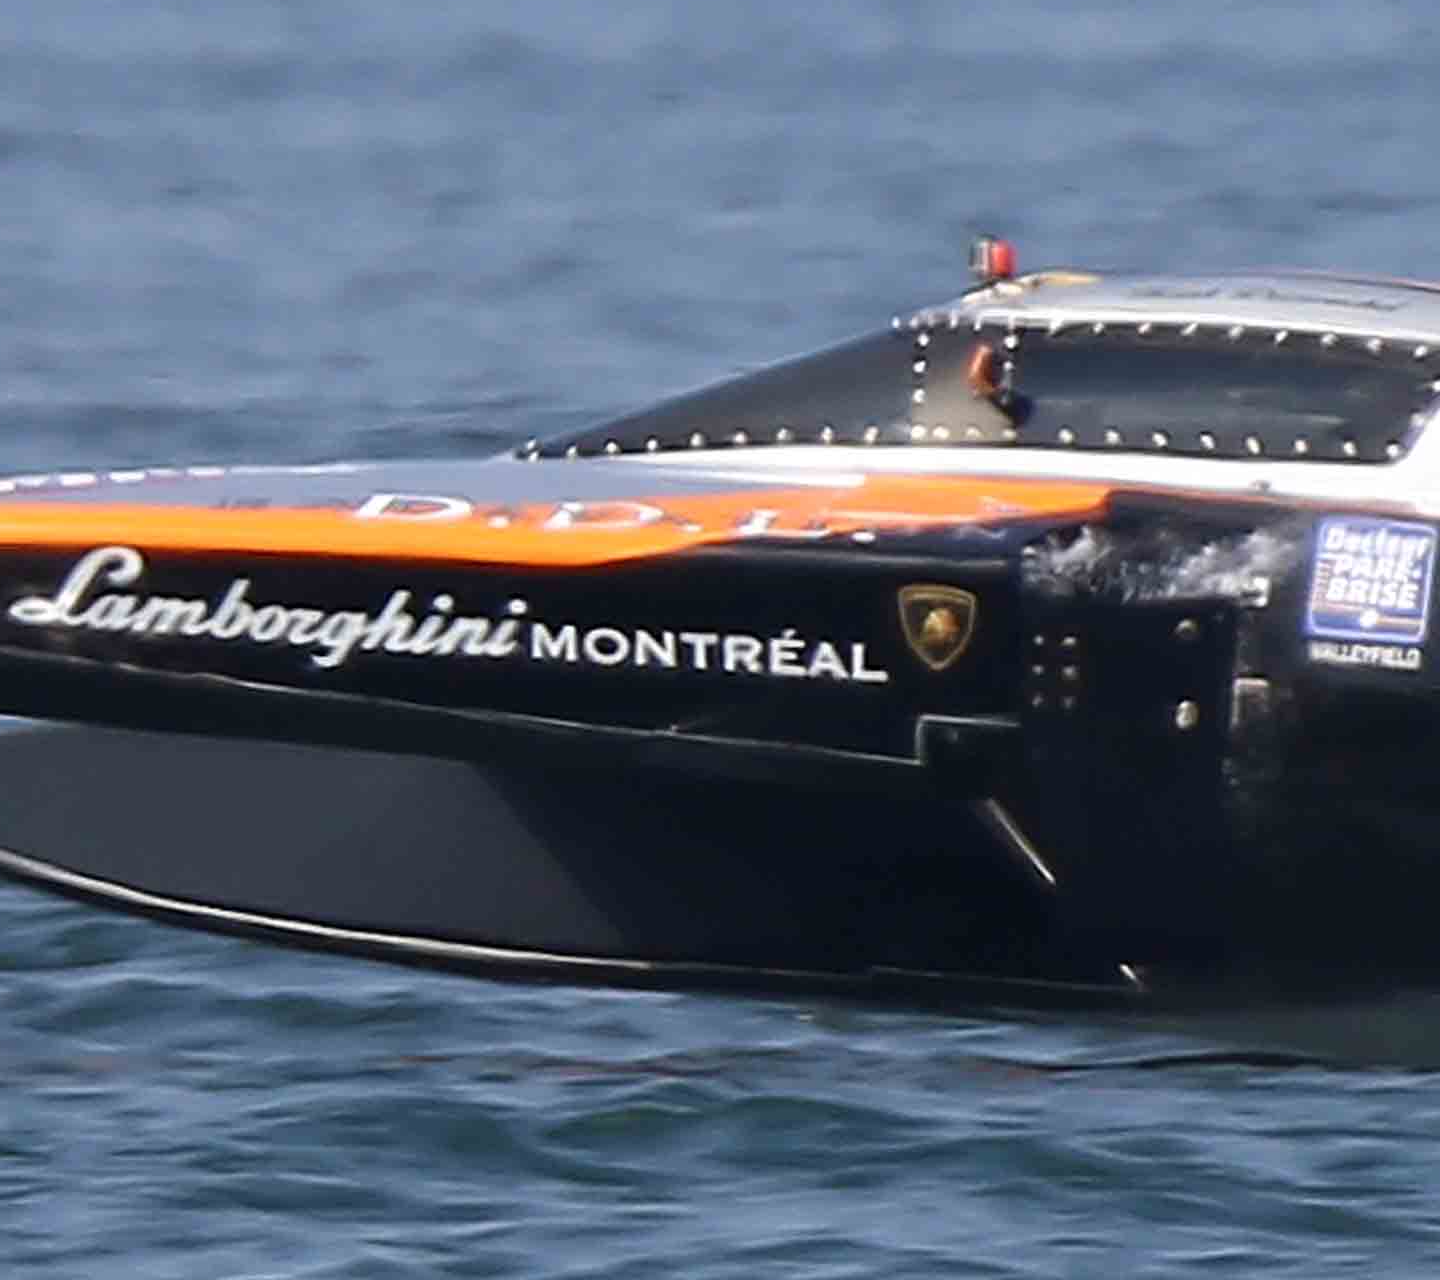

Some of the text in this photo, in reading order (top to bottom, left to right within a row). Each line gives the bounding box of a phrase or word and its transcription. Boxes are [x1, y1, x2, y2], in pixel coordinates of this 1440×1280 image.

[8, 545, 890, 683] Lamborghini MONTRÉAL
[1325, 577, 1420, 609] BRISE
